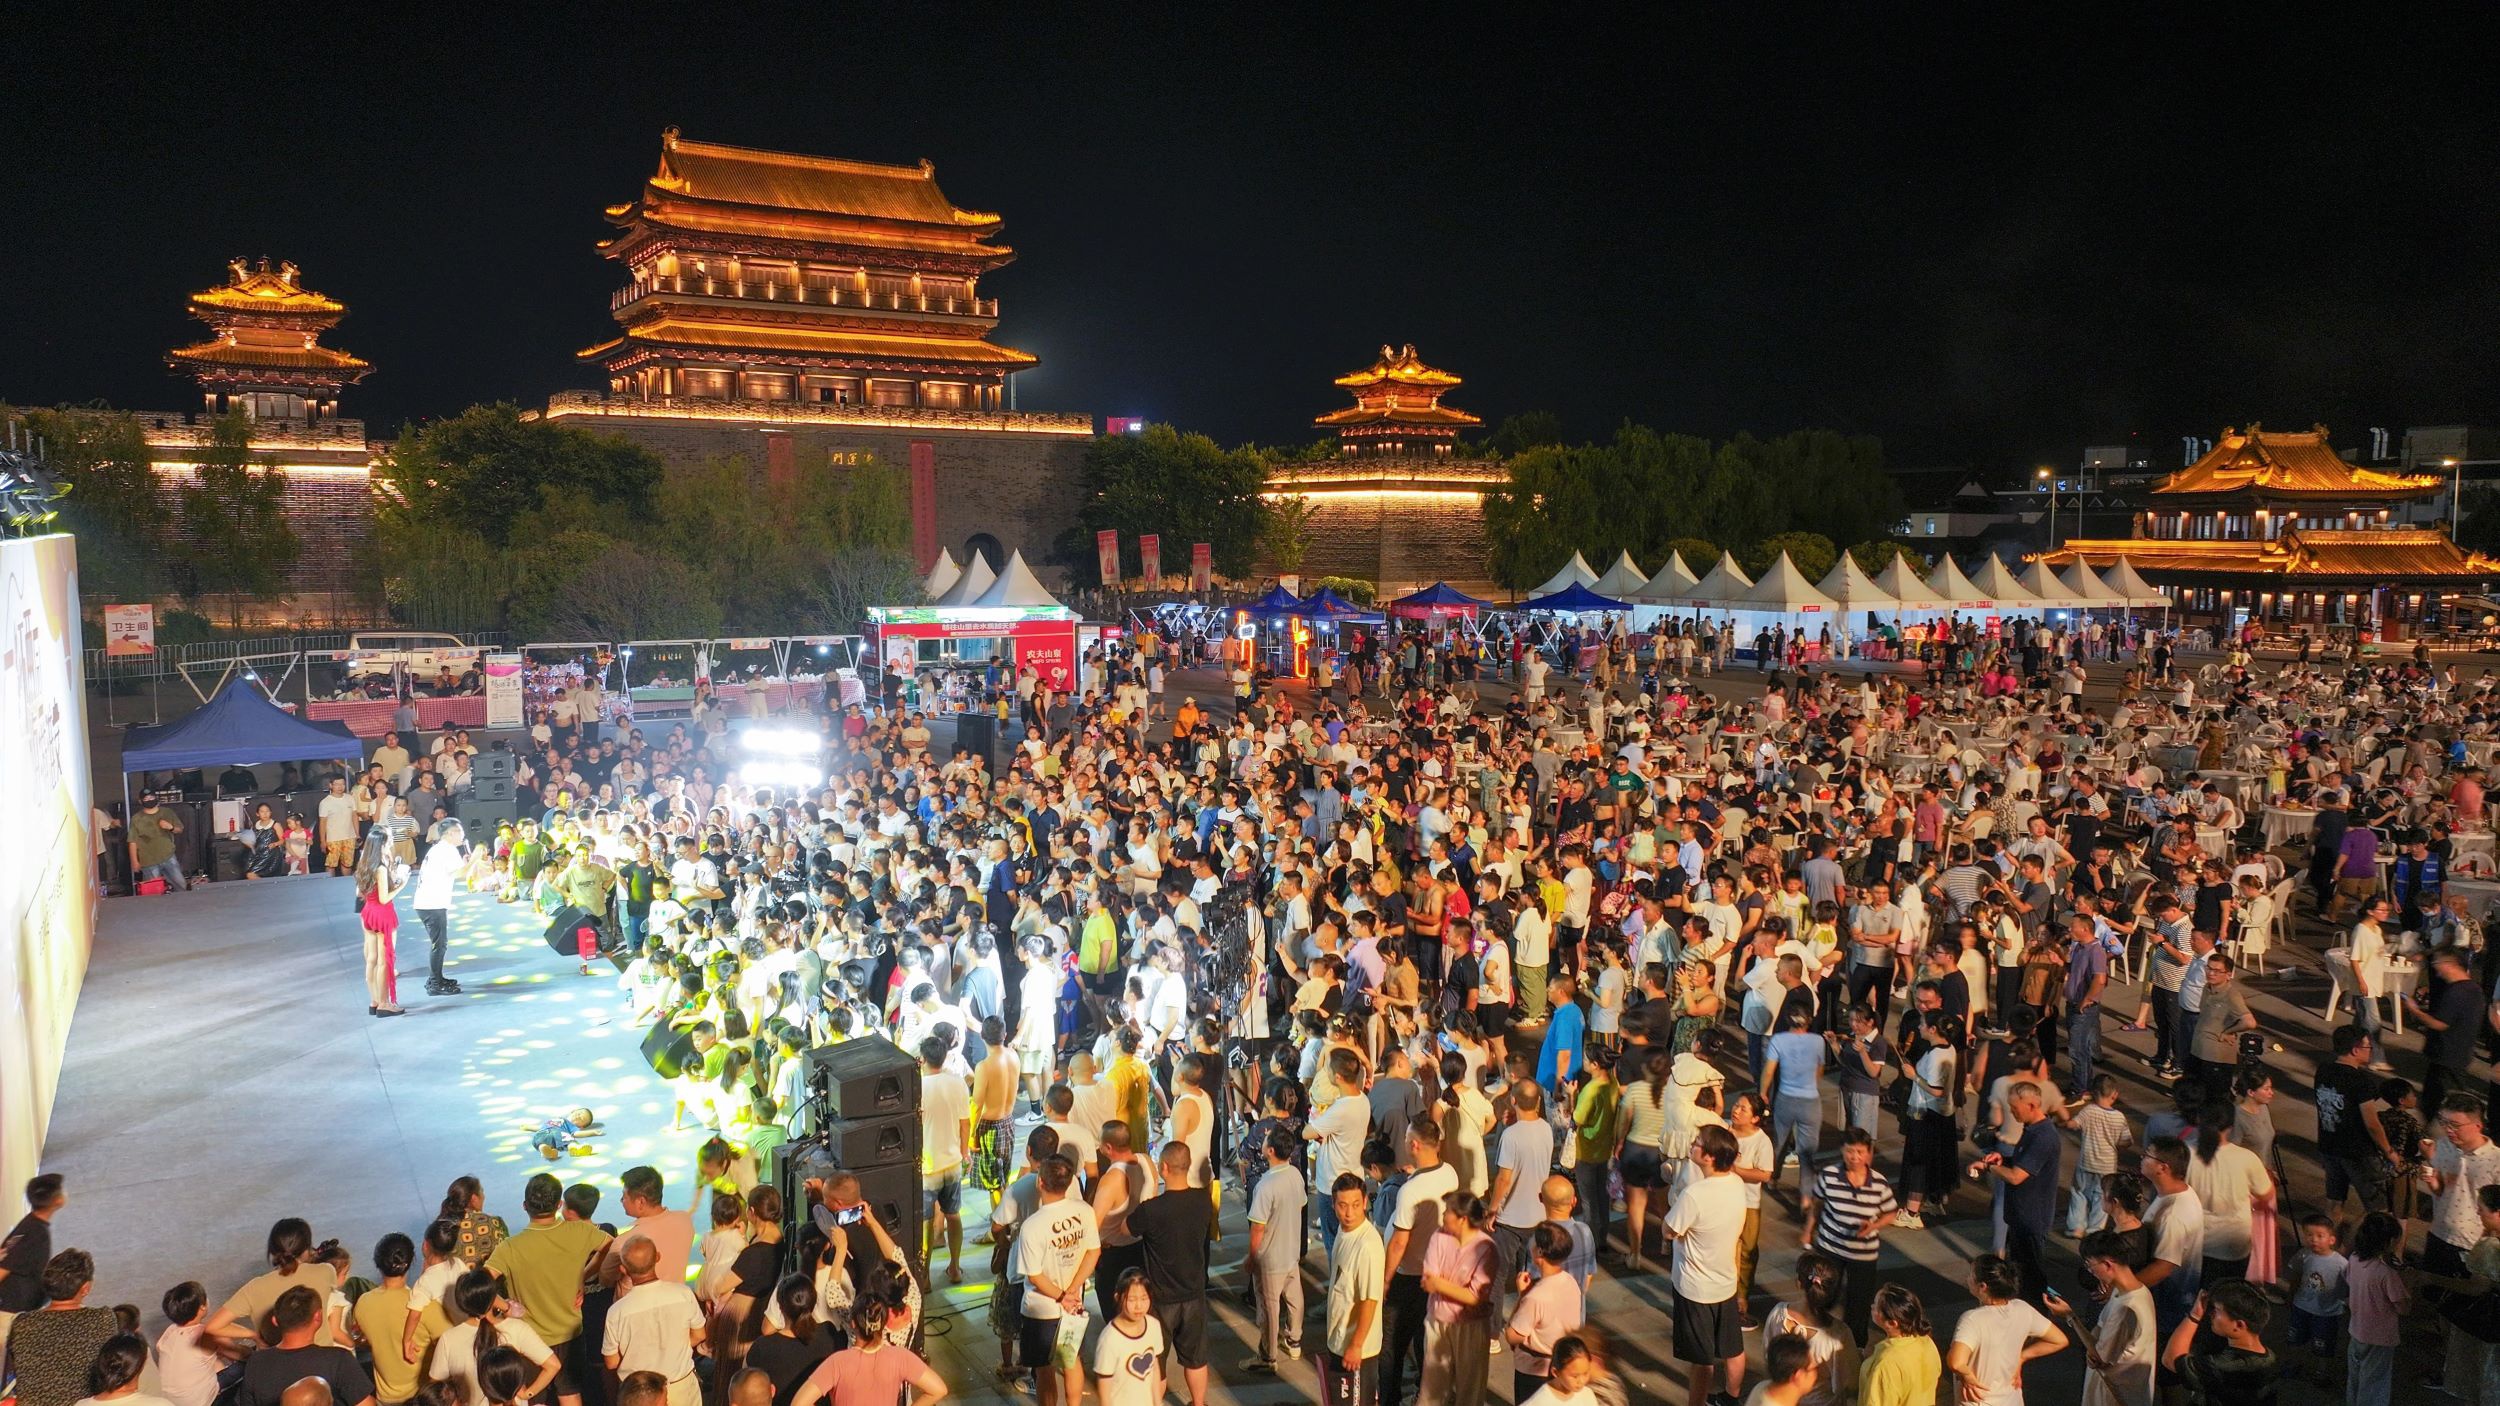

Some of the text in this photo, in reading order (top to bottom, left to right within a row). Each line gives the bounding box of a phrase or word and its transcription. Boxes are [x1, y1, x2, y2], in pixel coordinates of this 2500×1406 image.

[112, 622, 148, 632] 卫生间
[1026, 649, 1062, 659] 农夫山泉
[1051, 1214, 1082, 1234] CON
[1340, 1377, 1350, 1399] FILA
